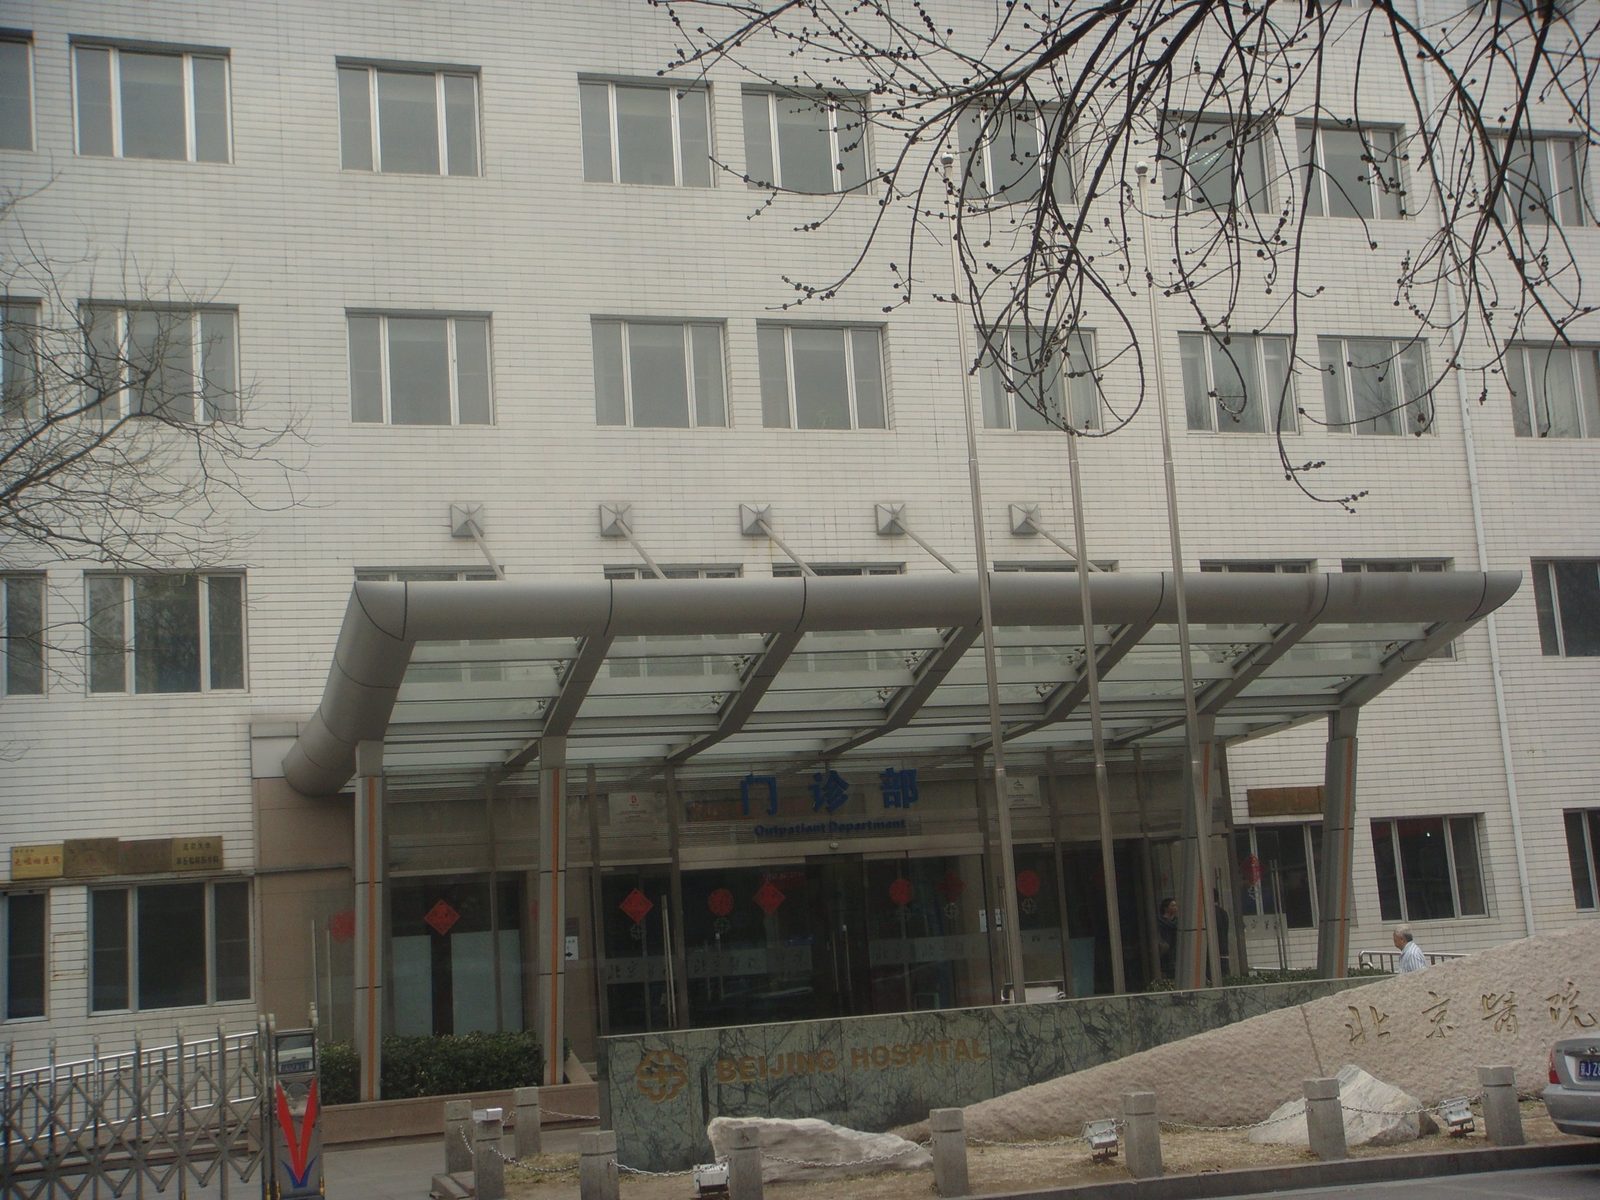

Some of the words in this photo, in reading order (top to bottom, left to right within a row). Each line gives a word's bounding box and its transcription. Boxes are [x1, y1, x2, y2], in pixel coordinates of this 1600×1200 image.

[740, 767, 918, 816] 门诊部
[754, 821, 826, 837] Outpatient
[828, 818, 906, 834] Department
[715, 1049, 838, 1085] BEIJING
[850, 1037, 990, 1073] HOSPITAL
